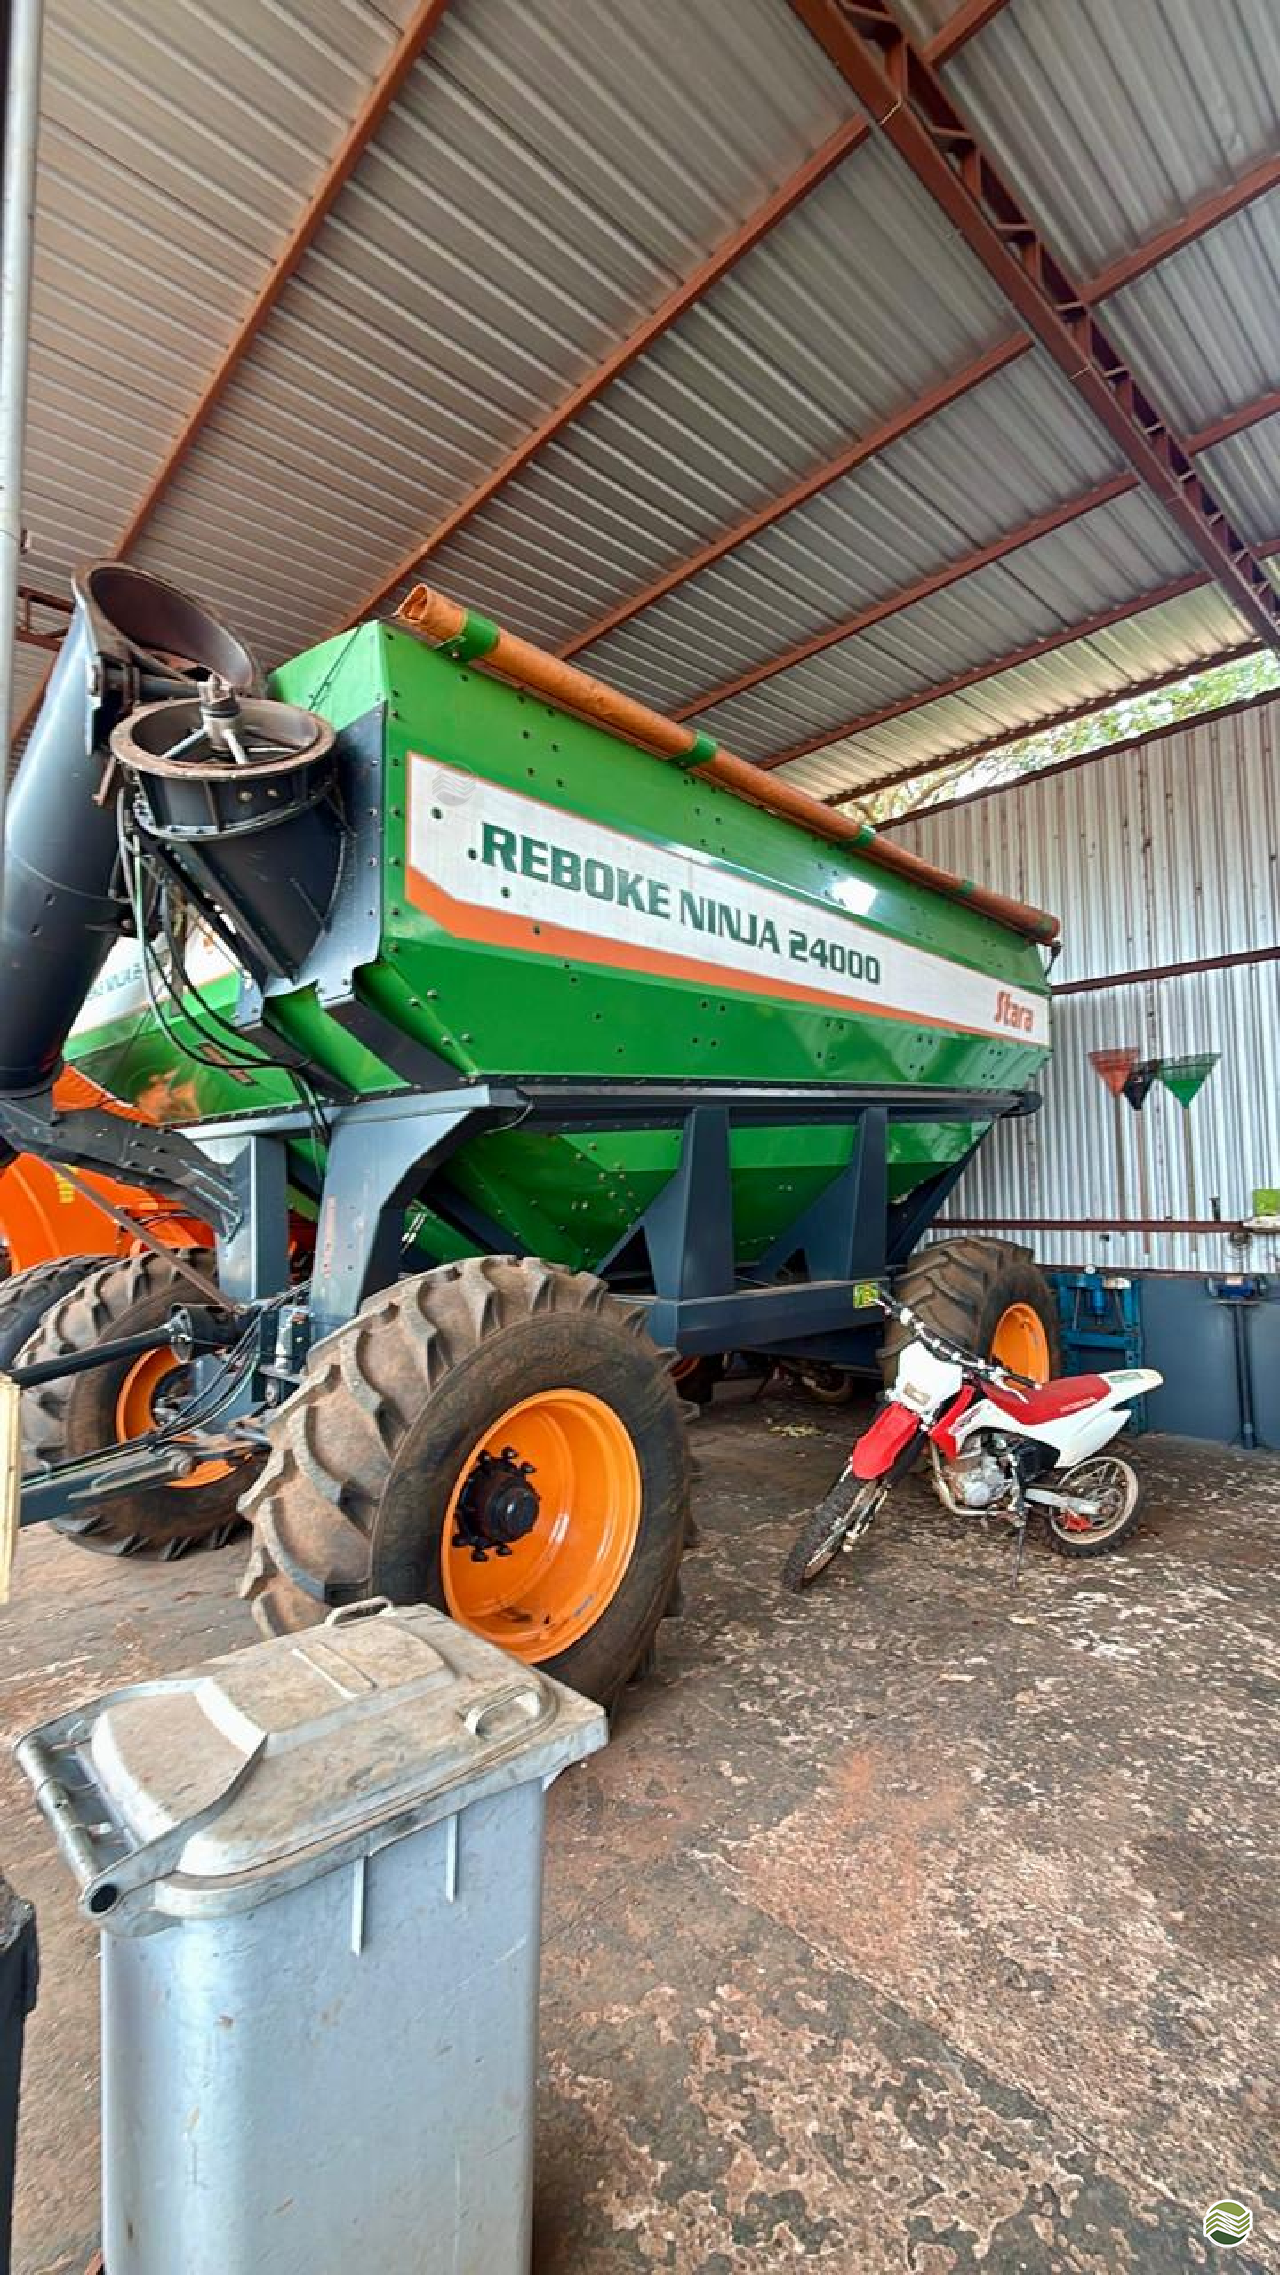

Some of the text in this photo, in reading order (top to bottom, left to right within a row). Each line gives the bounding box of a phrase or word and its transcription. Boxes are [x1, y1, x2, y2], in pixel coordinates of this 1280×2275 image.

[481, 821, 880, 984] REBOKE NINJA 24000
[994, 990, 1034, 1033] Stara
